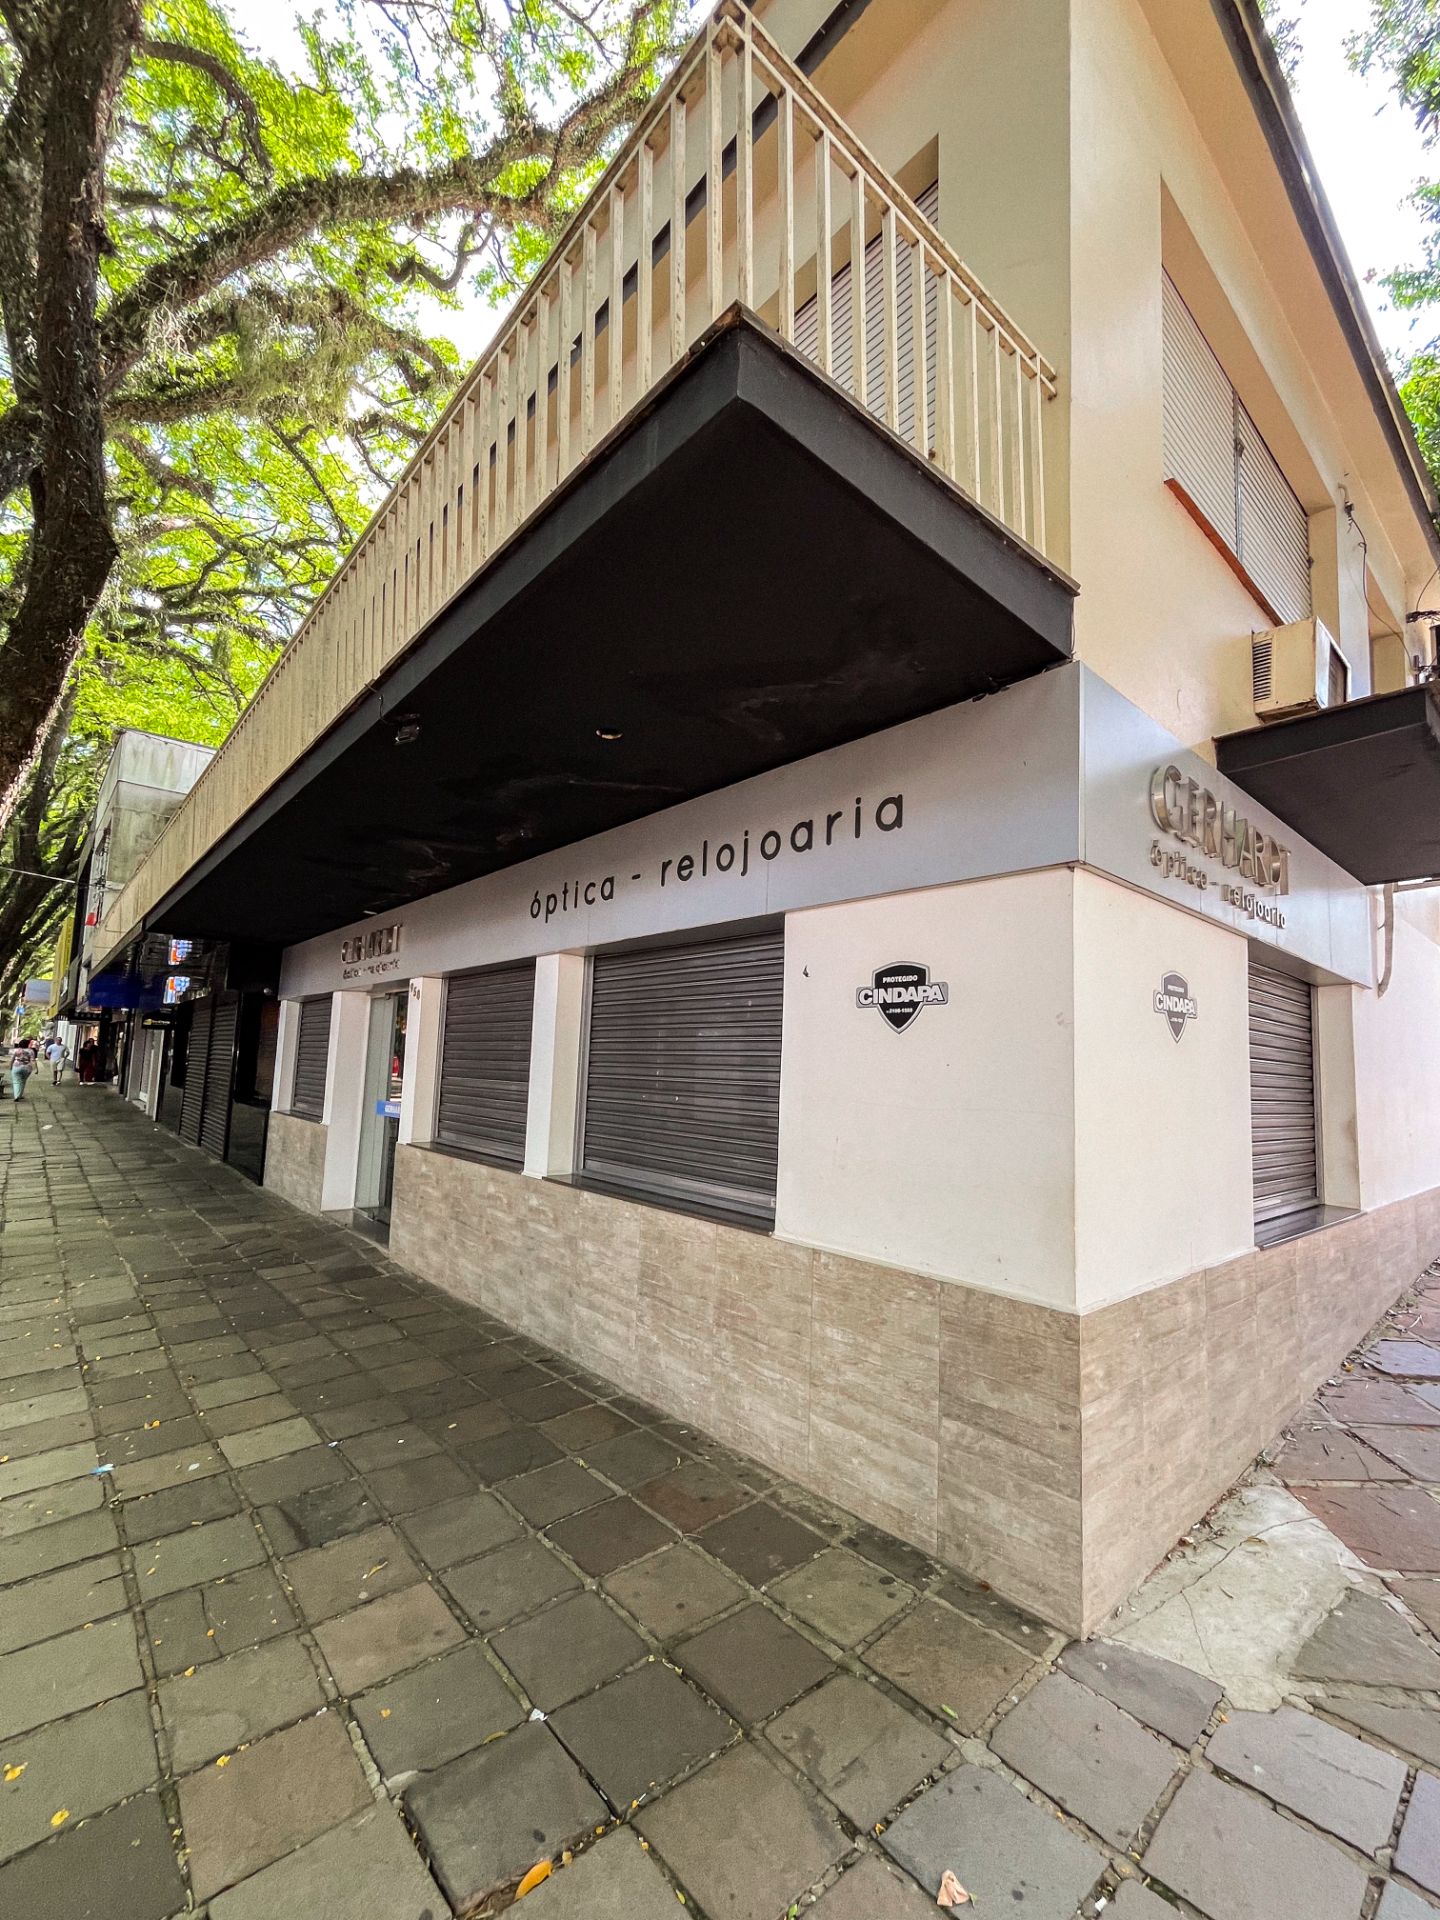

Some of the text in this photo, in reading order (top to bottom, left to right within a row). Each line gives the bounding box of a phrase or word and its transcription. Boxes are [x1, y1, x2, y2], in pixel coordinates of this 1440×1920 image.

[530, 876, 615, 923] óptica
[660, 794, 903, 887] relojoaria
[882, 975, 918, 983] PROTEGIDO
[859, 984, 945, 1005] CINDAPA
[1156, 992, 1197, 1016] CINDAPA
